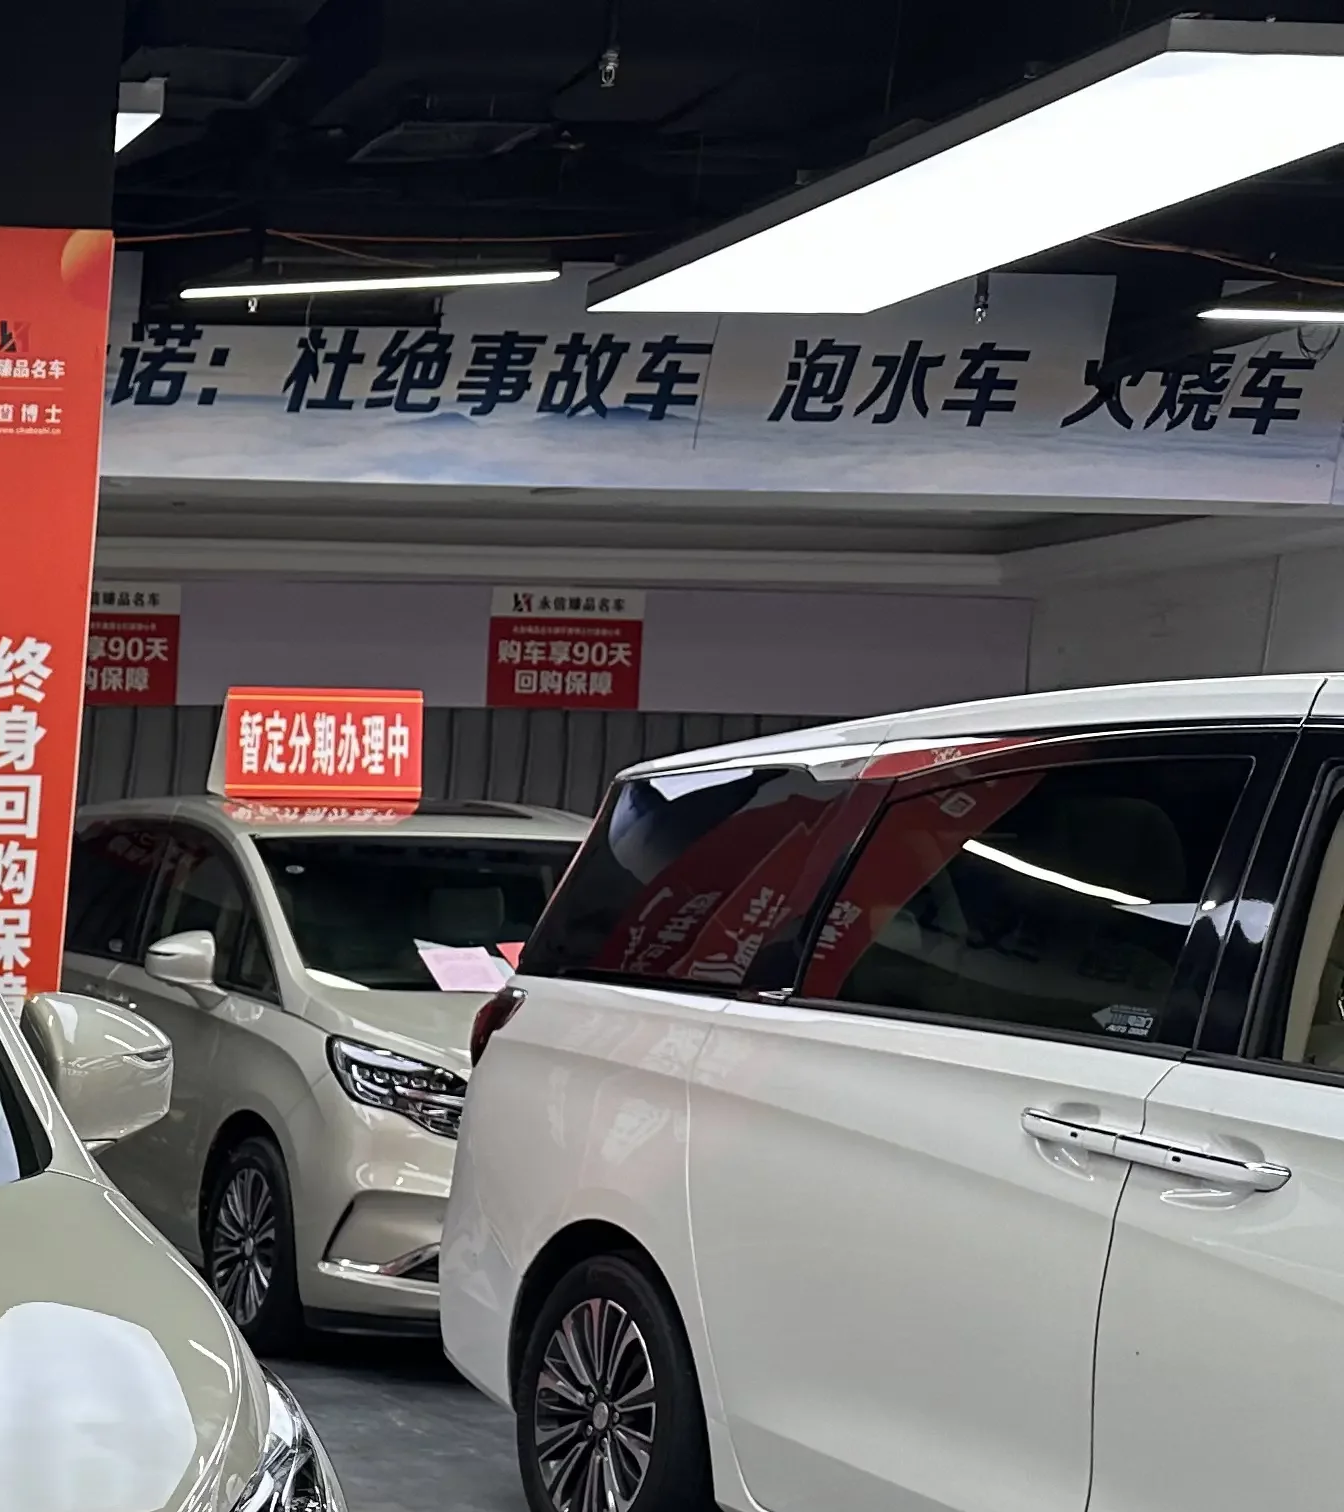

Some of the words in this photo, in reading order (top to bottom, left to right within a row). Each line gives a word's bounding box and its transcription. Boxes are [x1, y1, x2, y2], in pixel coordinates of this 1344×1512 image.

[767, 337, 1030, 427] 泡水车
[498, 639, 633, 667] 购车享90天
[514, 669, 613, 696] 回购保障
[239, 709, 410, 777] 暂定分期办理中
